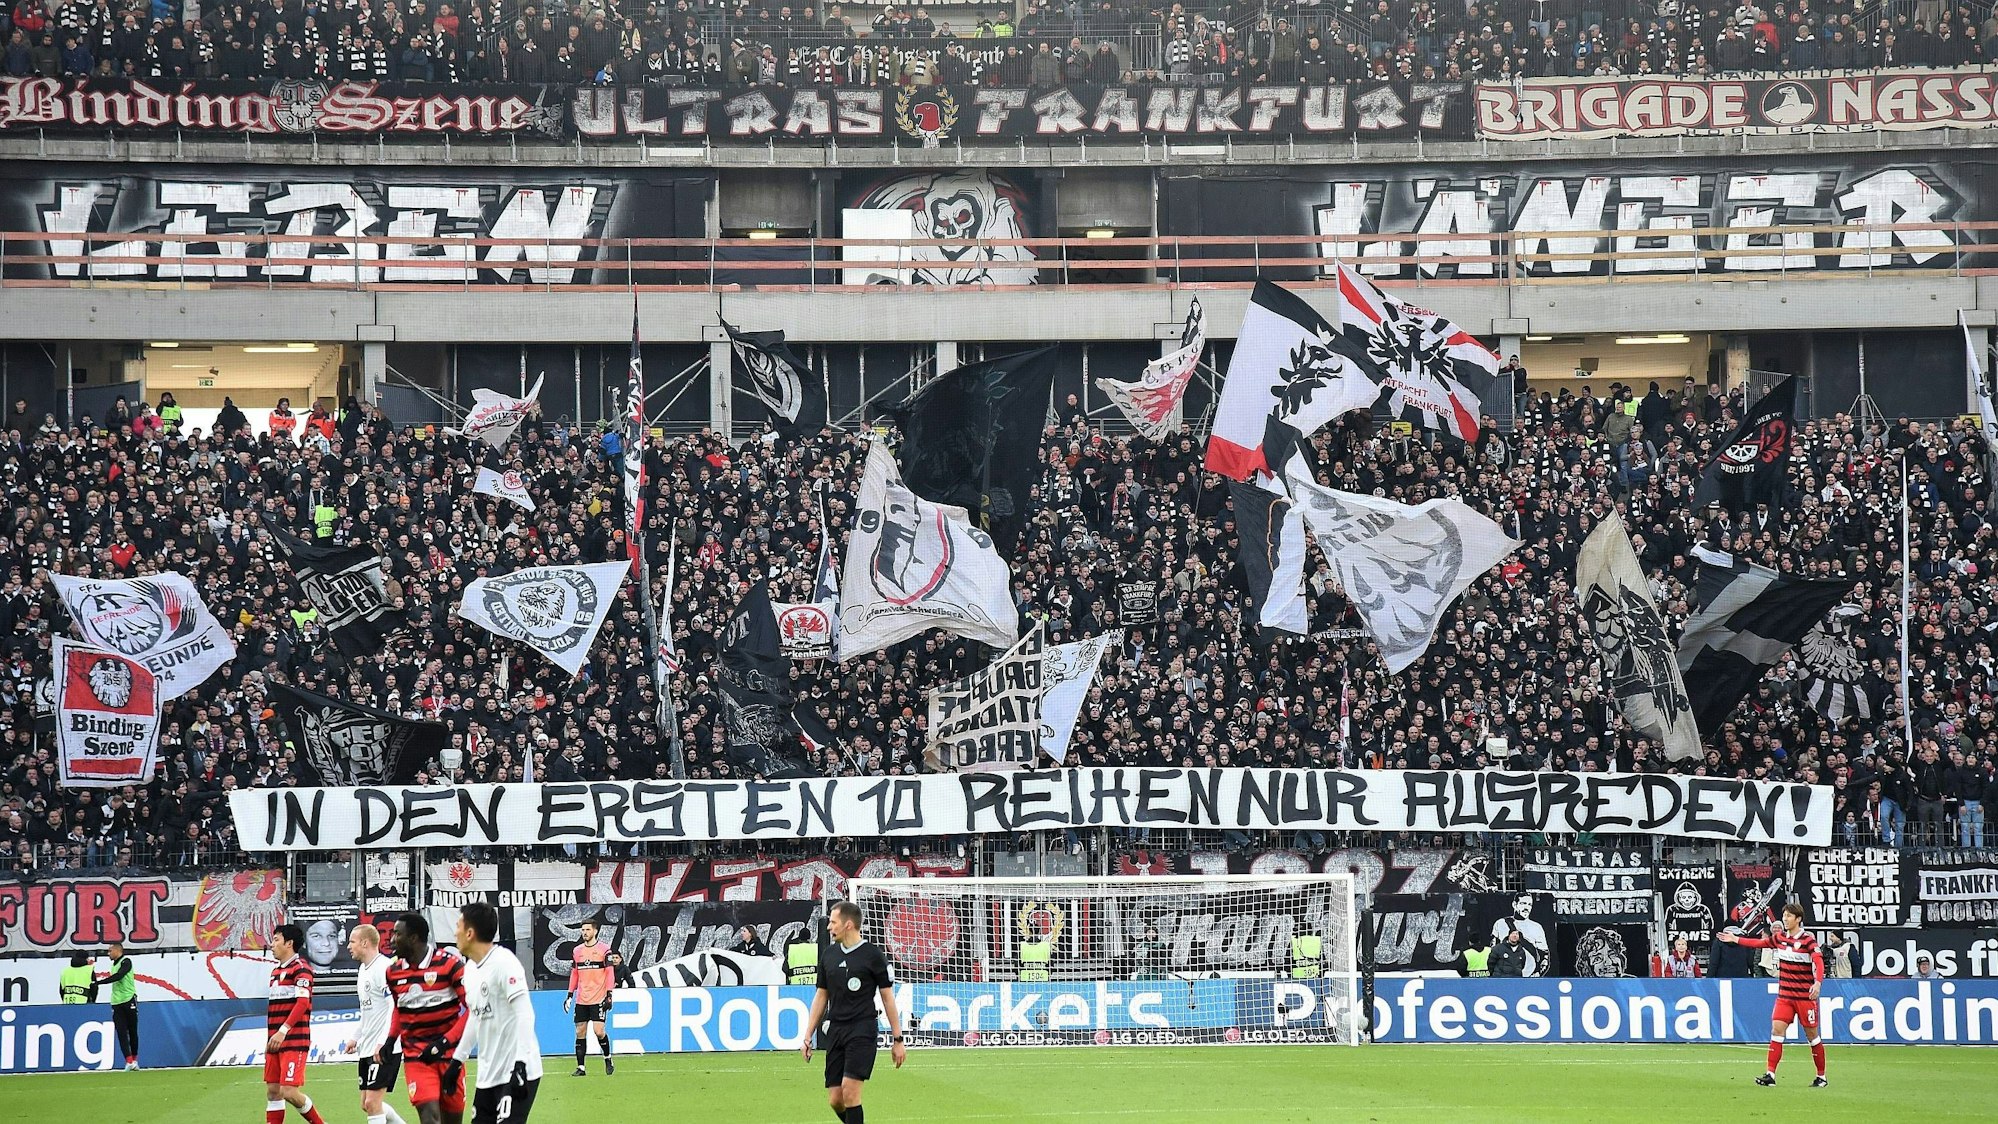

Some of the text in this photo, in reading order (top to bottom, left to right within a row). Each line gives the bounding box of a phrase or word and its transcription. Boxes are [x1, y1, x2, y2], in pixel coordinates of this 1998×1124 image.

[0, 75, 535, 133] Binding Szene
[572, 81, 1465, 136] ULTRAS FRANKFURT
[1475, 75, 1998, 133] BRIGADE NASS
[1402, 393, 1453, 418] FRANKFURT
[141, 635, 216, 673] EUNDE
[71, 713, 146, 741] Binding
[83, 737, 136, 756] Szene
[265, 768, 1814, 846] IN DEN ERSTEN 10 REIHEN NUR AUSREDEN!
[1535, 850, 1643, 868] ULTRAS
[1864, 848, 1900, 863] DER
[1544, 872, 1636, 891] NEVER
[1658, 866, 1716, 880] EXTREME
[1808, 864, 1900, 886] GRUPPE
[432, 889, 578, 908] NUOVA GUARDIA
[1811, 885, 1900, 905] STADION
[1553, 898, 1649, 916] RRENDER
[1812, 904, 1900, 926] VERBOT
[1861, 939, 1958, 978] Jobs
[1767, 980, 1998, 1042] radin
[1, 1008, 116, 1072] ing
[982, 1033, 1001, 1045] LG
[1005, 1033, 1046, 1045] OLED
[1112, 1032, 1133, 1044] LG
[1136, 1032, 1176, 1044] OLED
[1244, 1030, 1263, 1042] LG
[1267, 1030, 1306, 1042] OLED
[286, 1061, 296, 1078] 3
